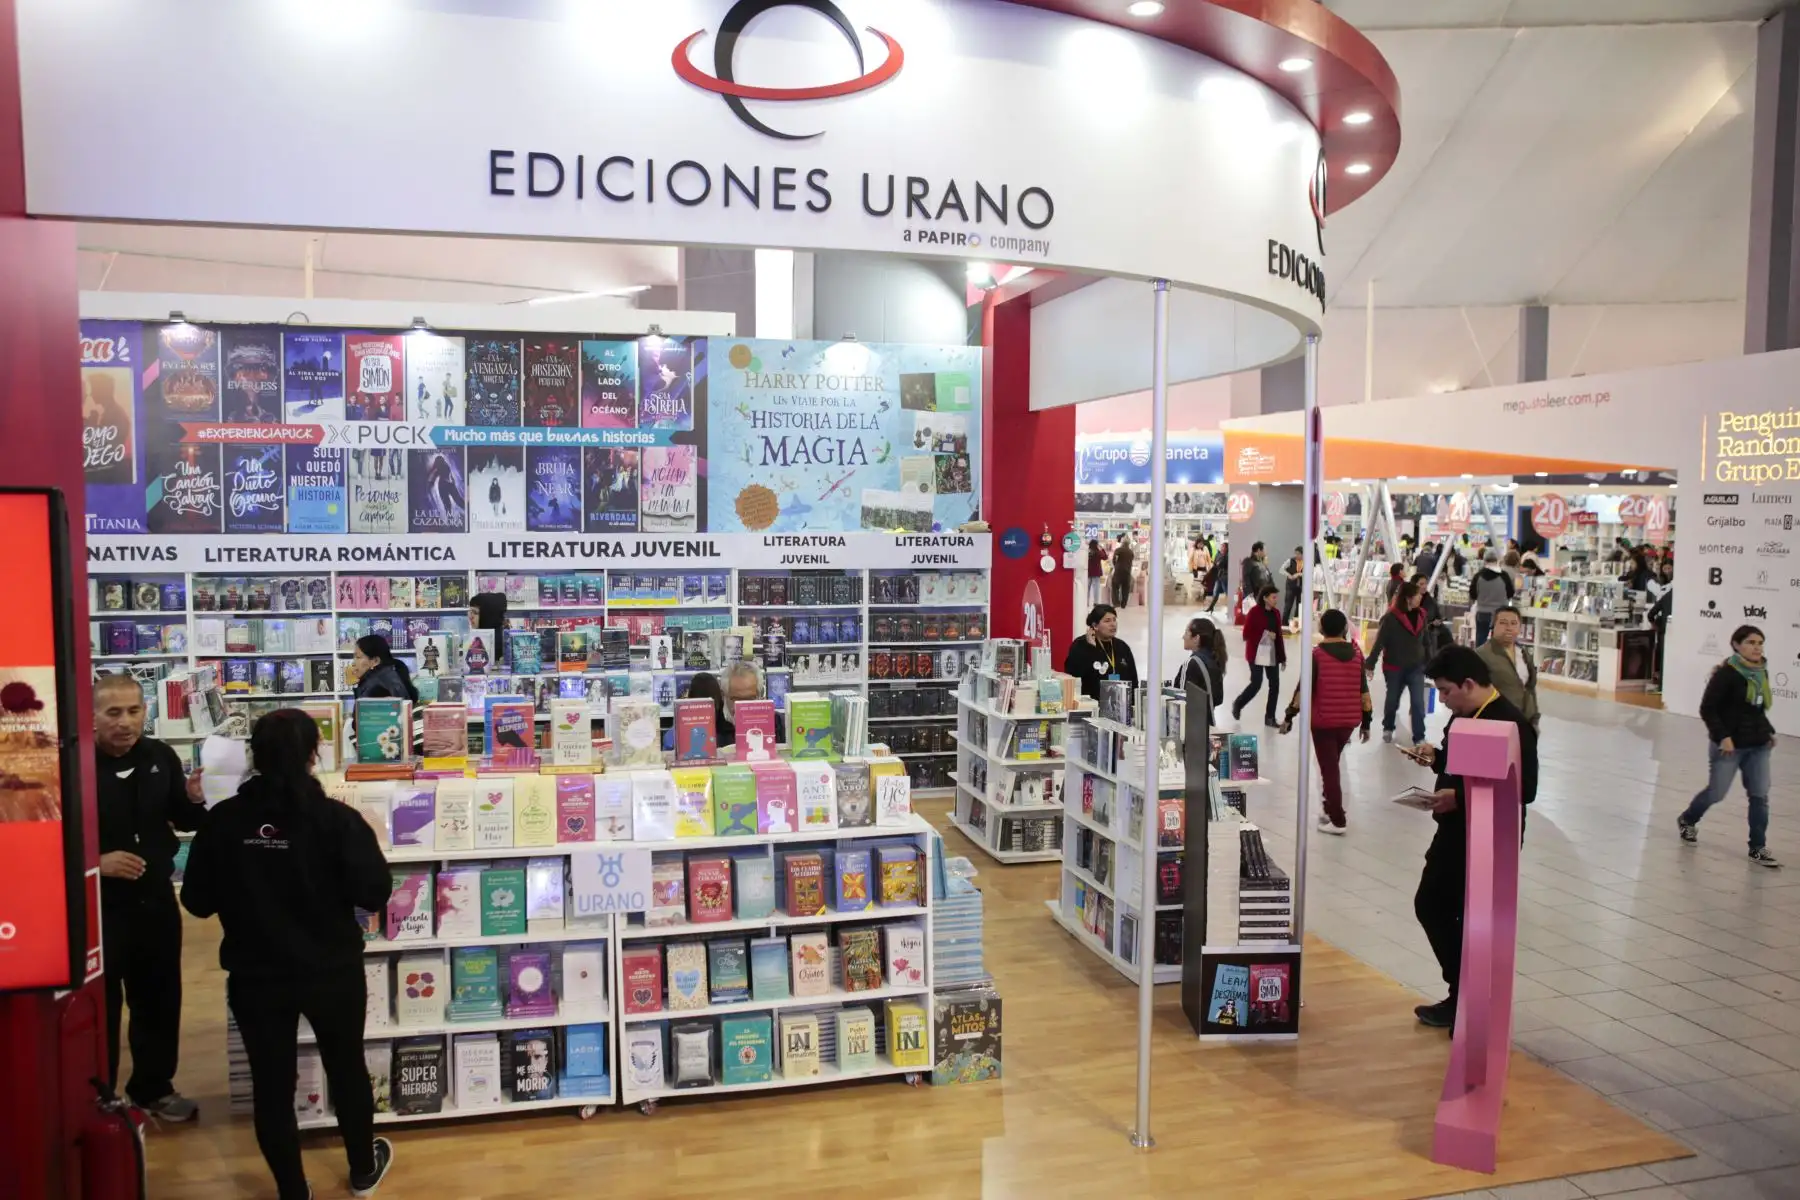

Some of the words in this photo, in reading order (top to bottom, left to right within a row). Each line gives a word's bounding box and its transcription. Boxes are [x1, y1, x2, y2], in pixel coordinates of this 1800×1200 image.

[489, 149, 832, 214] EDICIONES
[862, 172, 1055, 231] URANO
[903, 227, 912, 242] a
[918, 229, 981, 248] PAPIRO
[989, 234, 1051, 255] company
[473, 363, 514, 374] VENGANZA
[598, 363, 622, 371] OTRO
[227, 380, 278, 392] EVERLESS
[598, 378, 622, 386] LADO
[744, 371, 810, 390] HARRY
[815, 373, 885, 393] POTTER
[602, 392, 618, 400] DEL
[792, 395, 819, 406] VIAJE
[821, 396, 841, 407] POR
[844, 398, 856, 407] LA
[591, 404, 628, 415] OCÉANO
[751, 410, 832, 431] HISTORIA
[836, 412, 857, 429] DE
[860, 413, 880, 430] LA
[197, 427, 313, 440] #EXPERIENCIAPUCK
[358, 425, 428, 444] PUCK
[444, 428, 487, 441] Mucho
[490, 431, 516, 441] más
[518, 433, 542, 445] que
[546, 427, 599, 442] buenas
[602, 430, 656, 444] historias
[760, 435, 869, 466] MAGIA
[1094, 446, 1128, 464] Grupo
[1165, 445, 1209, 460] aneta
[306, 460, 341, 473] QUEDÓ
[1716, 460, 1783, 486] Grupo
[291, 475, 335, 487] NUESTRA
[298, 489, 341, 501] HISTORIA
[1752, 492, 1792, 504] Lumen
[1229, 494, 1250, 512] 20
[1620, 498, 1647, 517] 20
[589, 512, 637, 521] RIVERDALE
[1536, 498, 1564, 525] 20
[1647, 500, 1663, 530] 20
[84, 514, 140, 531] TITANIA
[1707, 516, 1746, 527] Grijalbo
[764, 536, 846, 547] LITERATURA
[895, 536, 974, 547] LITERATURA
[205, 547, 331, 562] LITERATURA
[337, 543, 456, 561] ROMÁNTICA
[488, 541, 629, 559] LITERATURA
[631, 541, 721, 558] JUVENIL
[1699, 544, 1744, 555] Montena
[780, 554, 830, 564] JUVENIL
[911, 554, 959, 564] JUVENIL
[1709, 567, 1722, 585] B
[1744, 605, 1767, 619] blok
[1771, 688, 1798, 700] RIGEN
[579, 891, 644, 912] URANO
[1221, 974, 1248, 988] LEAH
[951, 1012, 980, 1025] ATLAS
[952, 1022, 985, 1035] MITOS
[401, 1066, 437, 1083] SUPER
[401, 1081, 438, 1096] HIERBAS
[517, 1077, 549, 1092] MORIR
